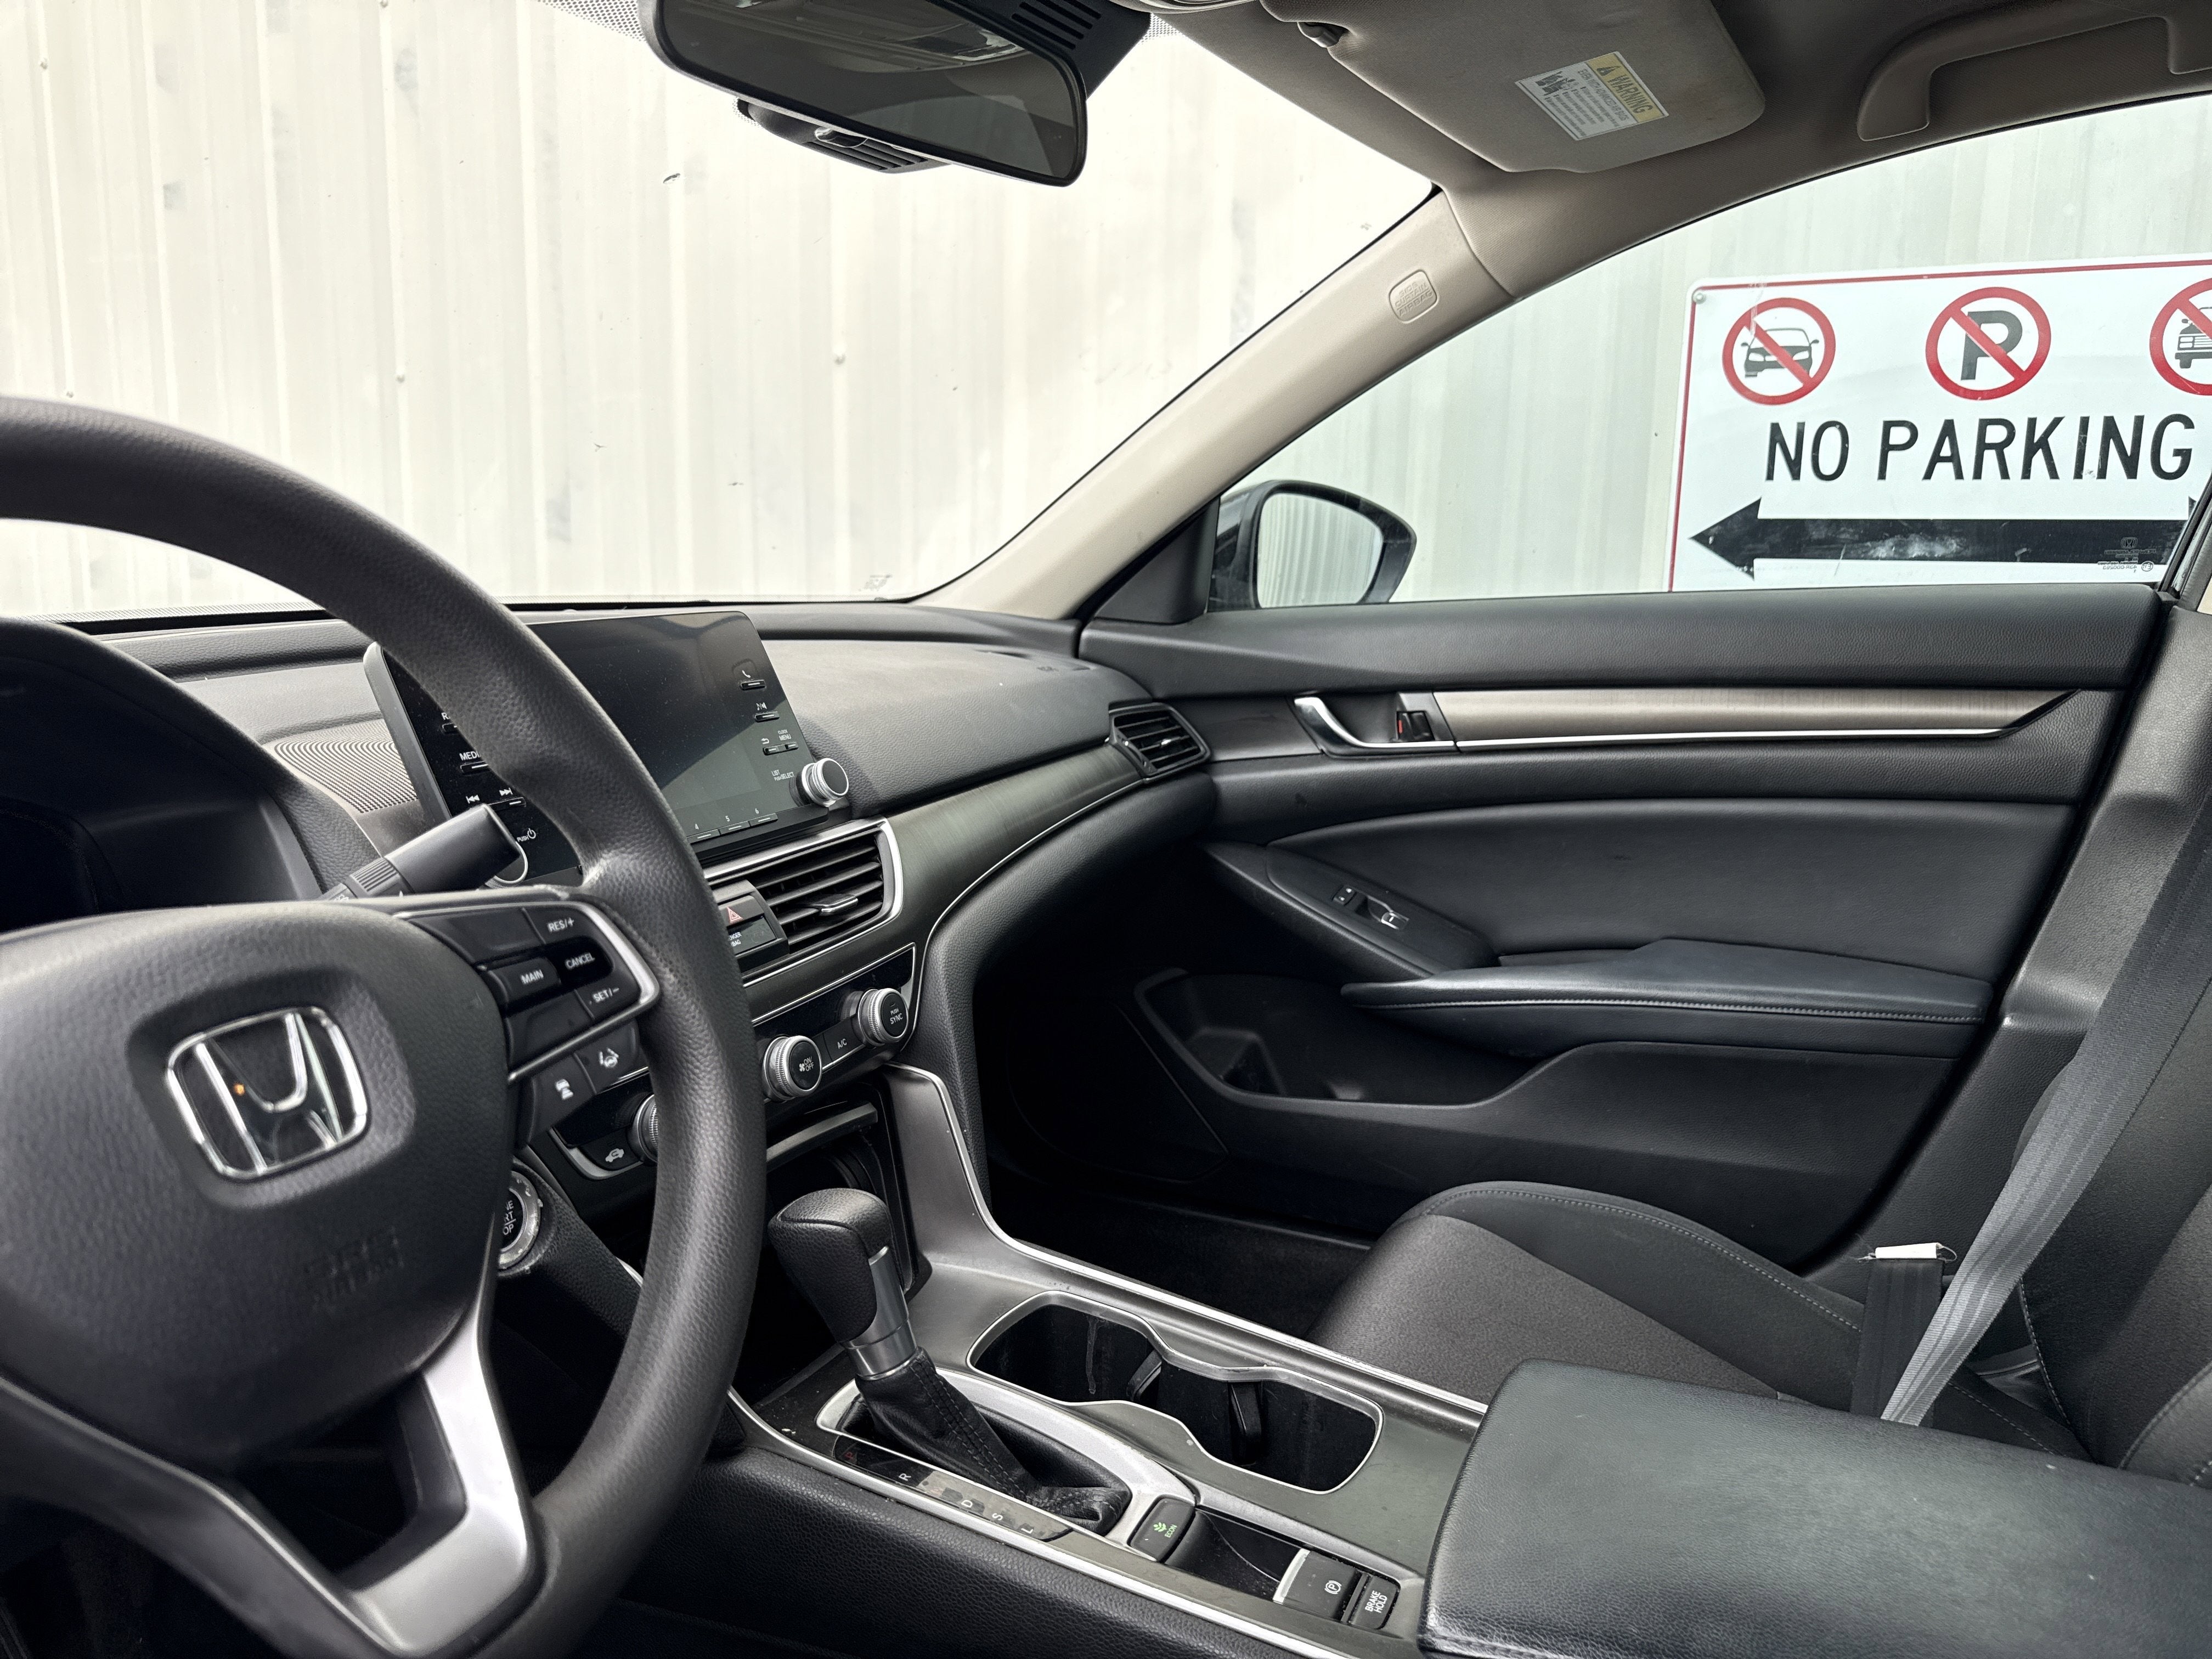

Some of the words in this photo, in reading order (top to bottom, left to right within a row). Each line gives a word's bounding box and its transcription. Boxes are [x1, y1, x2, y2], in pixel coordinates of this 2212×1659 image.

[1607, 74, 1653, 114] WARNING
[1395, 283, 1426, 307] CURTAIN
[1399, 291, 1433, 317] AIRBAG
[1767, 421, 1849, 481] NO
[1878, 414, 2194, 480] PARKING
[459, 751, 481, 761] MEDI
[781, 771, 795, 780] SELECT
[547, 917, 574, 932] RES/+
[565, 952, 595, 970] CANCEL
[520, 969, 544, 985] MAIN
[890, 1013, 903, 1024] SYNC
[837, 1038, 847, 1049] A/C
[803, 1056, 812, 1066] ON/
[805, 1062, 814, 1071] OFF
[899, 1472, 912, 1481] R
[961, 1499, 973, 1508] D
[992, 1513, 1004, 1521] S
[1164, 1524, 1177, 1538] ECON
[1365, 1590, 1381, 1612] BRAKE
[1373, 1595, 1387, 1613] HOLD
